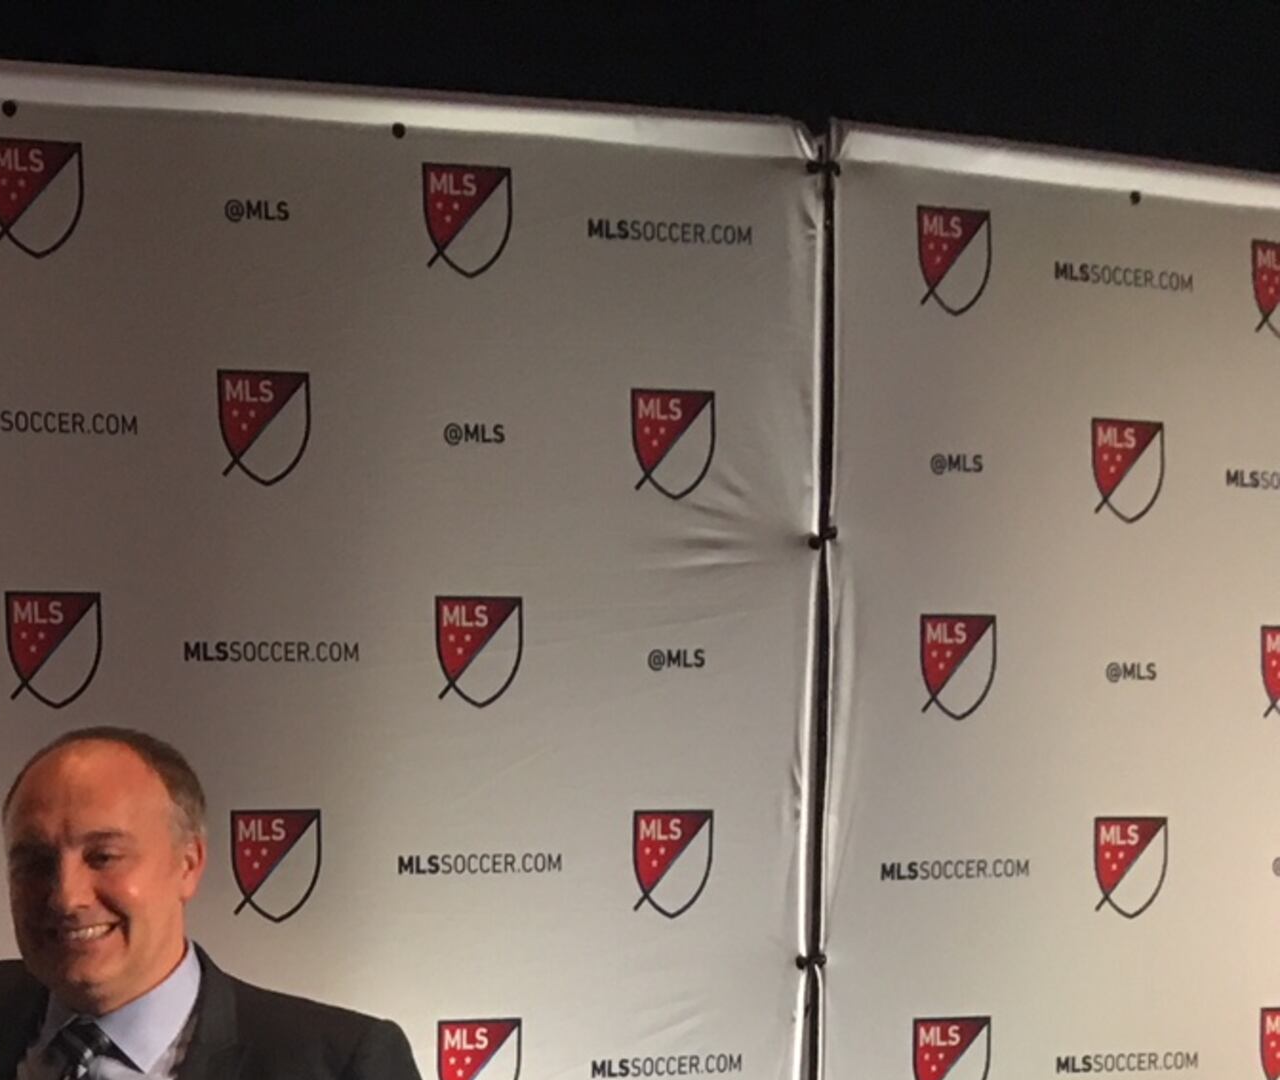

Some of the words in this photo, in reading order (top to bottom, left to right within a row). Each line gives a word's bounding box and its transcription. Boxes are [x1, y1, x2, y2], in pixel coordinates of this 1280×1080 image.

[429, 172, 477, 197] MLS
[224, 199, 290, 224] @MLS
[587, 218, 752, 245] MLSSOCCER.COM
[923, 213, 963, 239] MLS
[1257, 248, 1280, 271] ML
[1053, 260, 1193, 291] MLSSOCCER.COM
[225, 379, 274, 403] MLS
[637, 397, 683, 421] MLS
[443, 422, 506, 447] @MLS
[1097, 426, 1136, 449] MLS
[929, 453, 984, 476] @MLS
[13, 600, 64, 625] MLS
[442, 605, 489, 628] MLS
[926, 622, 967, 645] MLS
[183, 640, 359, 663] MLSSOCCER.COM
[647, 648, 706, 672] @MLS
[1105, 661, 1158, 684] @MLS
[238, 818, 286, 842] MLS
[639, 818, 682, 841] MLS
[1099, 824, 1139, 846] MLS
[397, 853, 562, 875] MLSSOCCER.COM
[880, 859, 1029, 881] MLSSOCCER.COM
[443, 1027, 489, 1050] MLS
[919, 1025, 961, 1047] MLS
[591, 1053, 743, 1079] MLSSOCCER.COM
[1055, 1051, 1198, 1074] MLSSOCCER.COM
